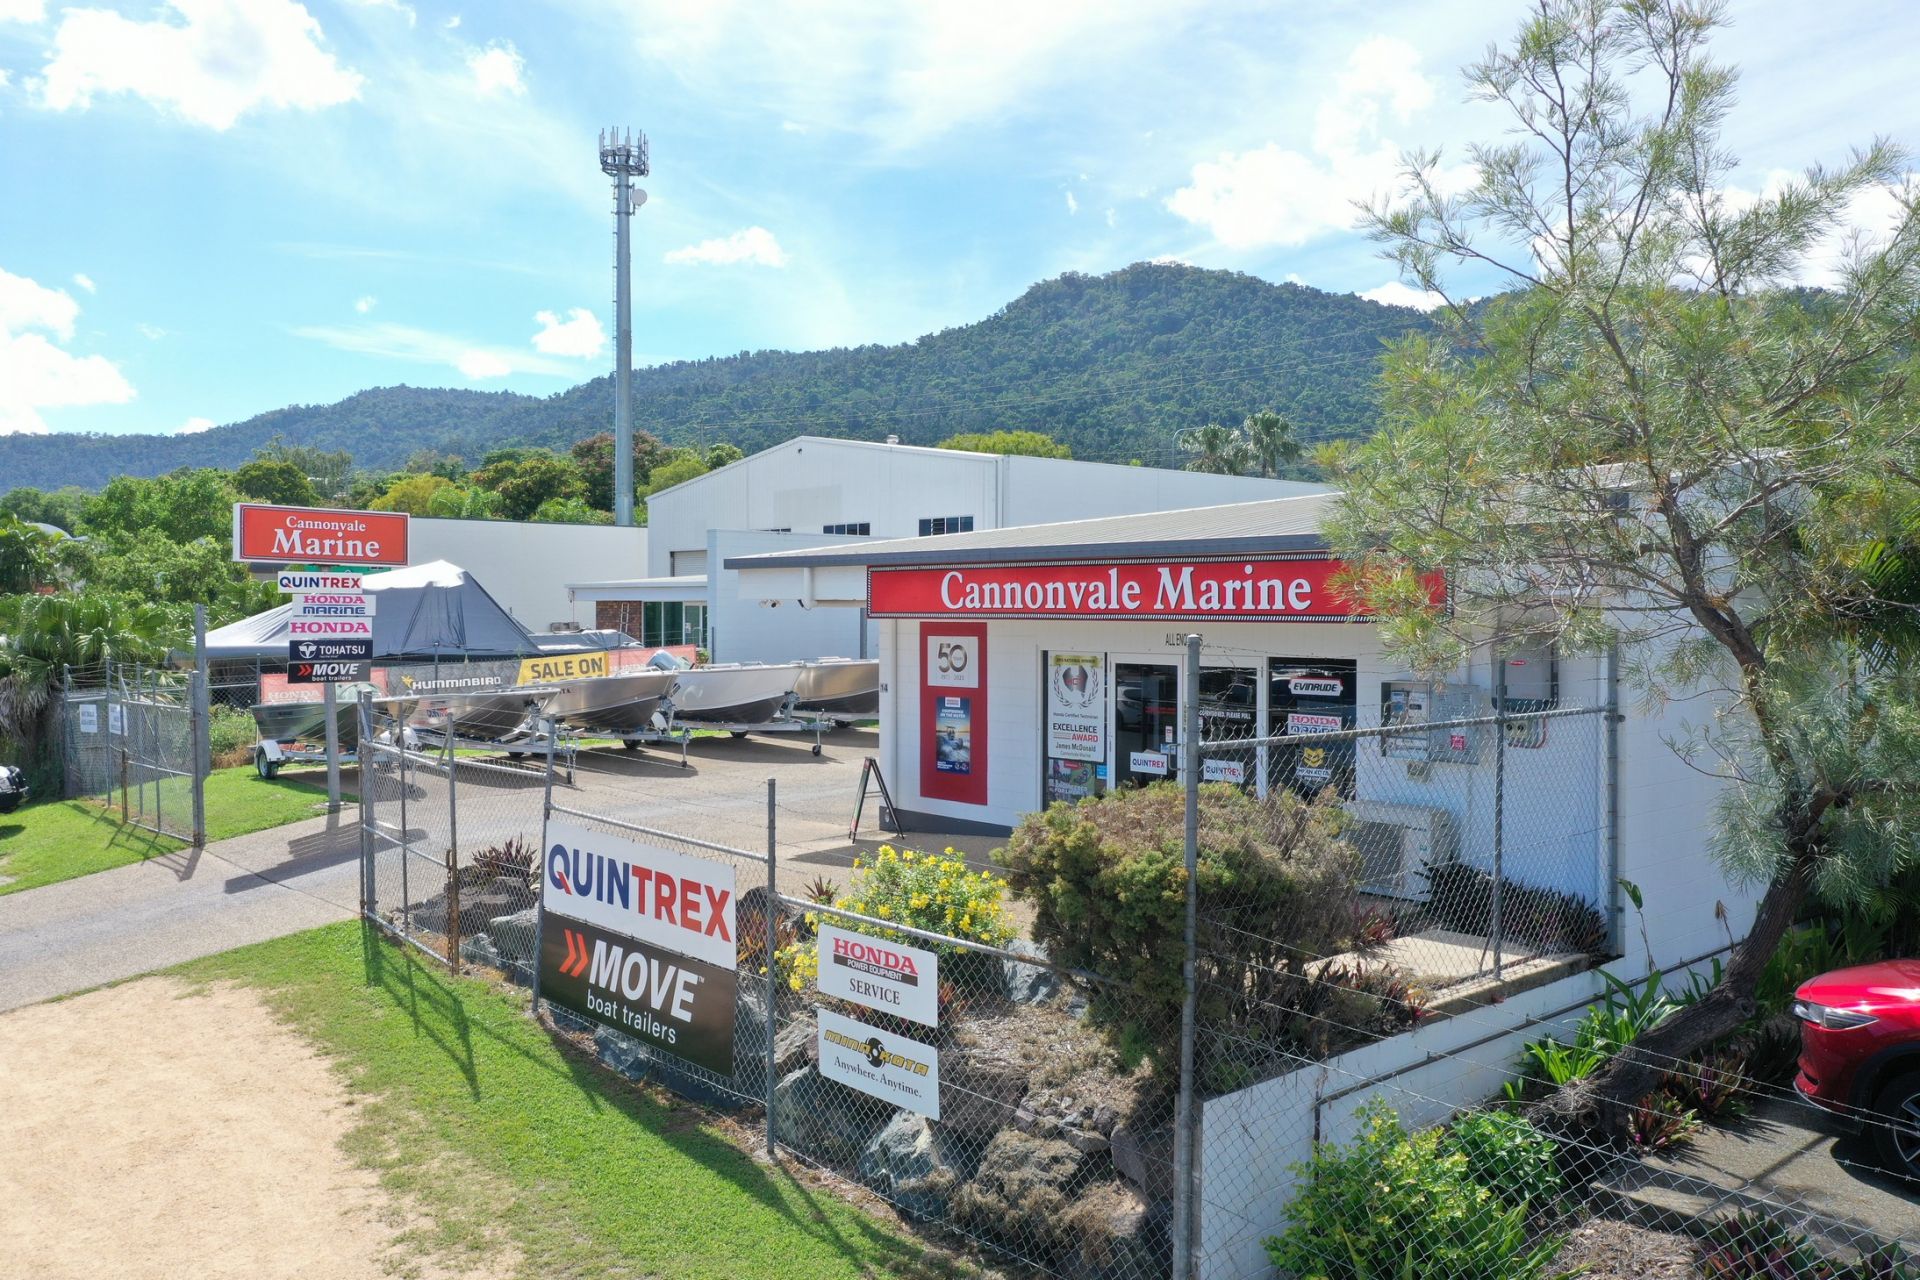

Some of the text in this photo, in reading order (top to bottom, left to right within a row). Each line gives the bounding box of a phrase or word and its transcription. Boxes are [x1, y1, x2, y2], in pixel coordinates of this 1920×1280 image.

[286, 516, 366, 532] Cannonvale
[271, 529, 380, 557] Marine
[279, 576, 361, 589] QUINTREX
[940, 565, 1312, 611] Cannonvale Marine
[303, 595, 366, 604] HONDA
[302, 606, 366, 615] MARINE
[290, 622, 370, 633] HONDA
[1165, 633, 1175, 646] ALL
[319, 645, 366, 655] TOHATSU
[938, 642, 968, 673] 50
[312, 663, 359, 676] MOVE
[530, 661, 574, 680] SALE
[578, 657, 603, 675] ON
[412, 676, 502, 690] HUMMINBIRD
[1293, 682, 1338, 692] EVINRUDE
[1290, 715, 1339, 726] HONDA
[1053, 723, 1098, 734] EXCELLENCE
[1071, 733, 1098, 743] AWARD
[1131, 758, 1165, 768] QUINTREX
[1205, 766, 1241, 776] QUINTREX
[547, 843, 732, 943] QUINTREX
[833, 937, 918, 976] HONDA
[847, 958, 902, 981] POWER EQUIPMENT
[588, 939, 699, 1023] MOVE
[850, 978, 900, 1006] SERVICE
[587, 990, 677, 1044] boat trailers
[824, 1029, 929, 1077] MINN KOTA
[834, 1056, 922, 1098] Anywhere. Anytime.
